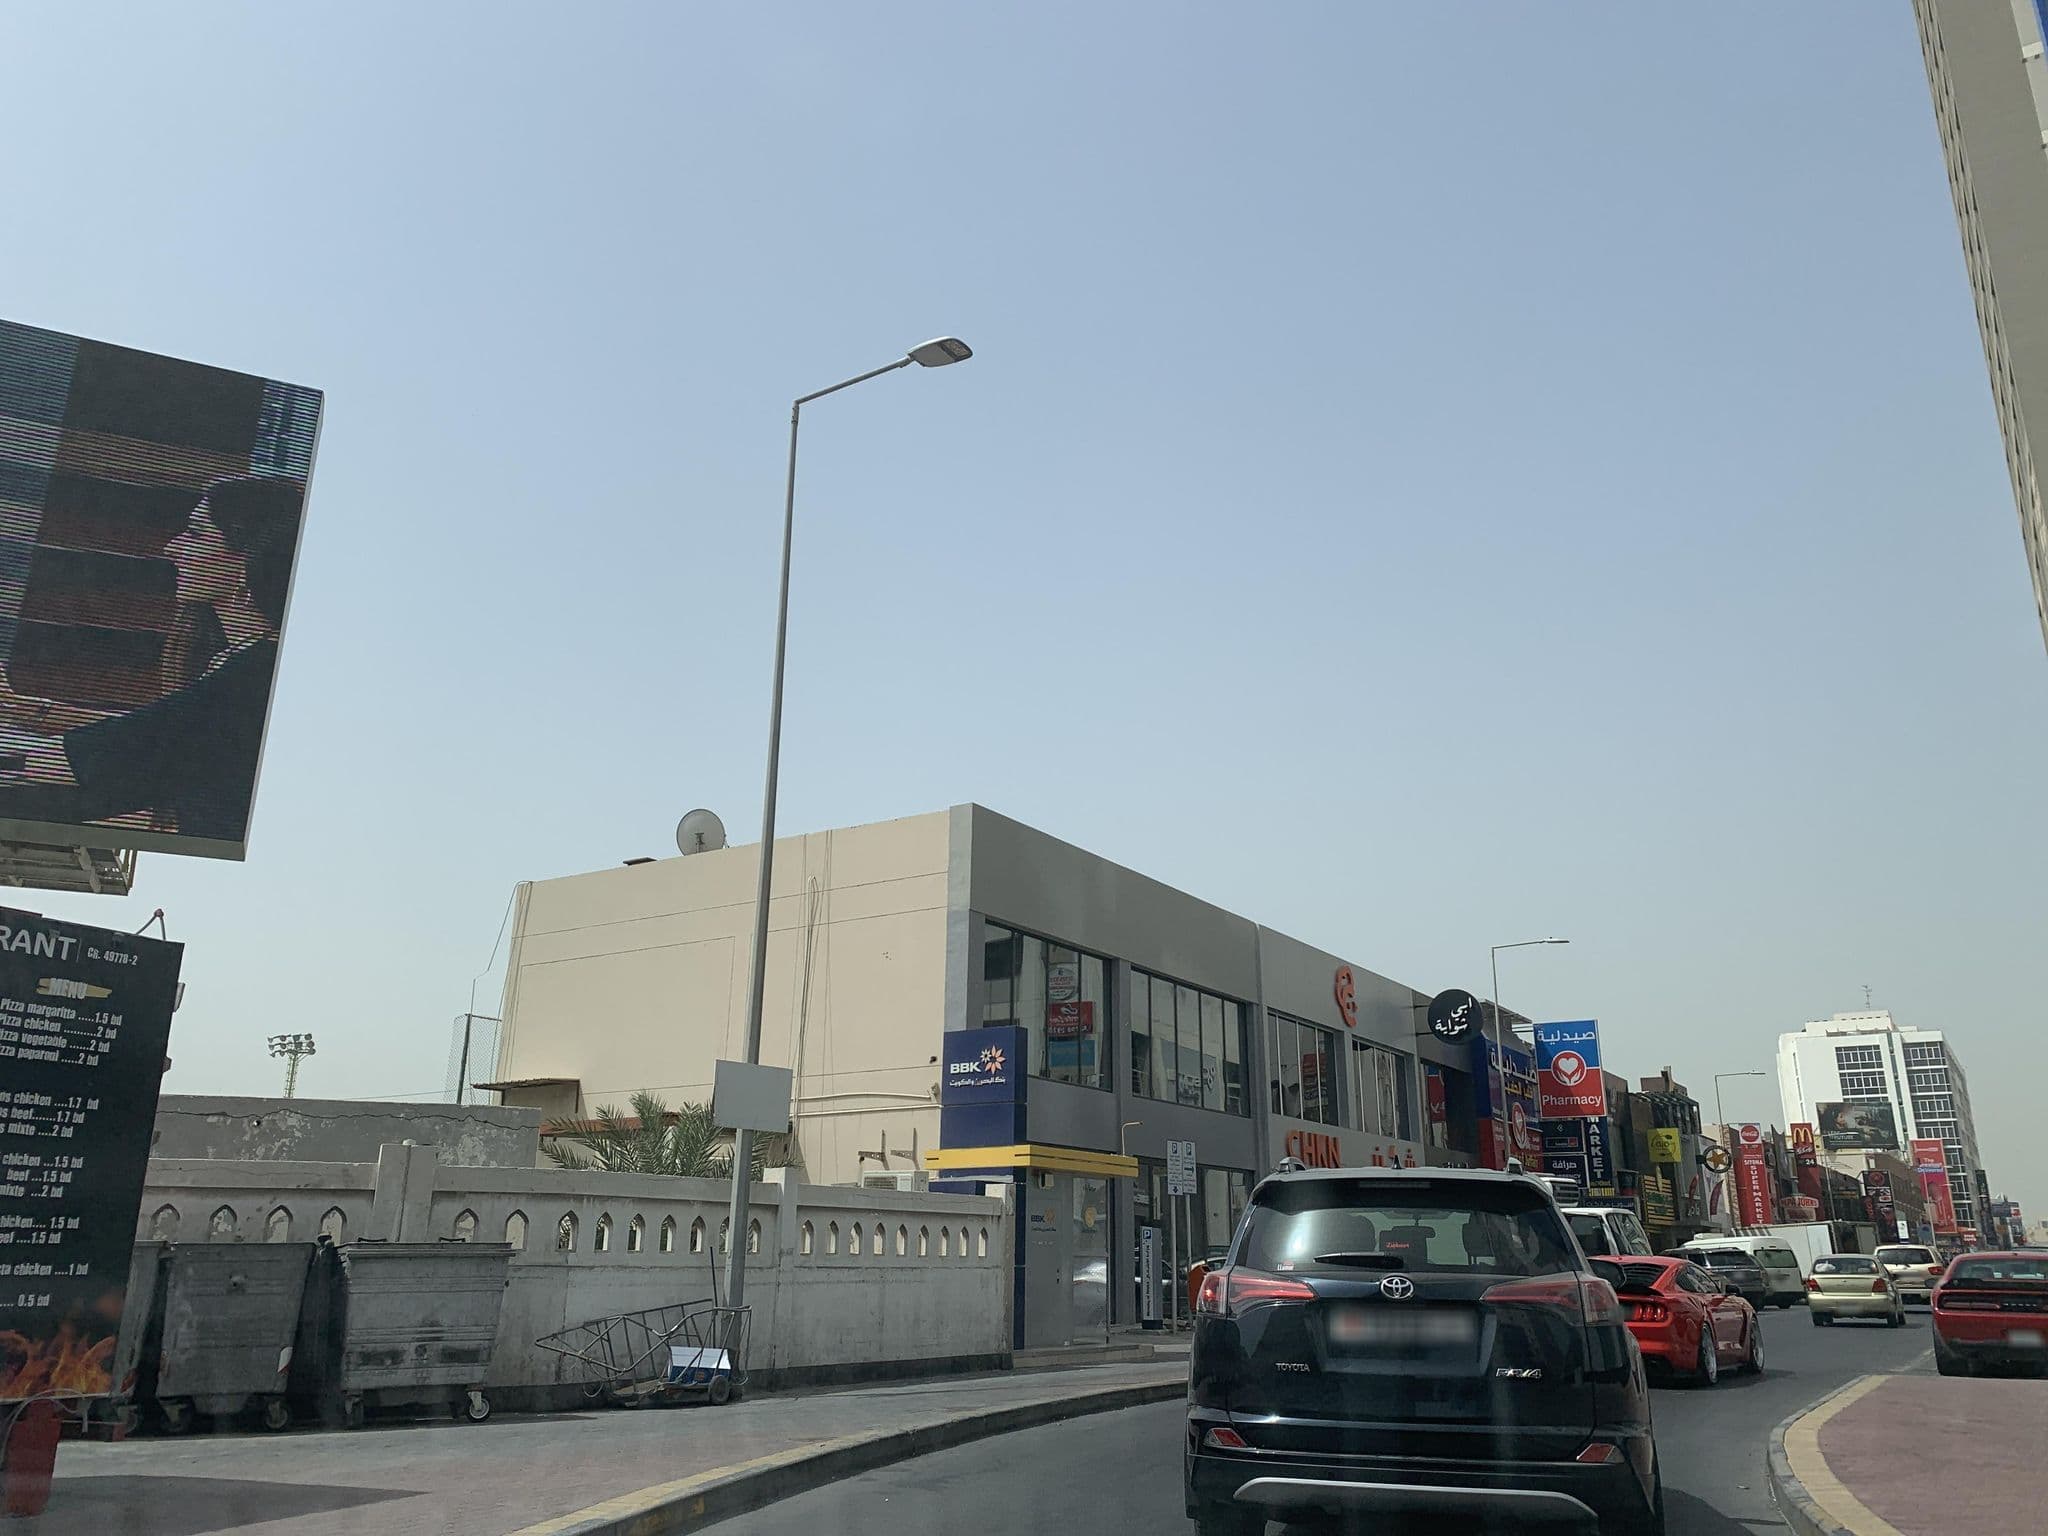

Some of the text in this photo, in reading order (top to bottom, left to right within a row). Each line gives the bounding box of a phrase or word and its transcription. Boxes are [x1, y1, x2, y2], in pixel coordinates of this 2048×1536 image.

[110, 1014, 123, 1026] bd
[24, 1017, 61, 1032] chicken
[105, 1028, 117, 1039] bd
[21, 1032, 67, 1048] vegetable
[98, 1041, 110, 1053] bd
[1537, 1030, 1596, 1045] صيدلية
[86, 1054, 99, 1066] bd
[950, 1062, 981, 1074] BBK
[13, 1092, 52, 1106] chicken
[87, 1098, 99, 1110] bd
[1542, 1095, 1602, 1107] Pharmacy
[72, 1112, 85, 1124] bd
[60, 1126, 74, 1138] bd
[1286, 1129, 1342, 1169] CHKN
[1587, 1117, 1603, 1179] MARKET
[1, 1153, 41, 1167] chicken
[70, 1156, 84, 1169] bd
[1552, 1160, 1577, 1170] صرافة
[6, 1169, 31, 1182] beef
[59, 1171, 72, 1183] bd
[50, 1186, 64, 1198] bd
[66, 1217, 80, 1229] bd
[48, 1232, 62, 1244] bd
[13, 1263, 52, 1276] chicken
[75, 1263, 89, 1276] bd
[36, 1294, 50, 1307] bd
[1275, 1362, 1311, 1373] TOYOTA
